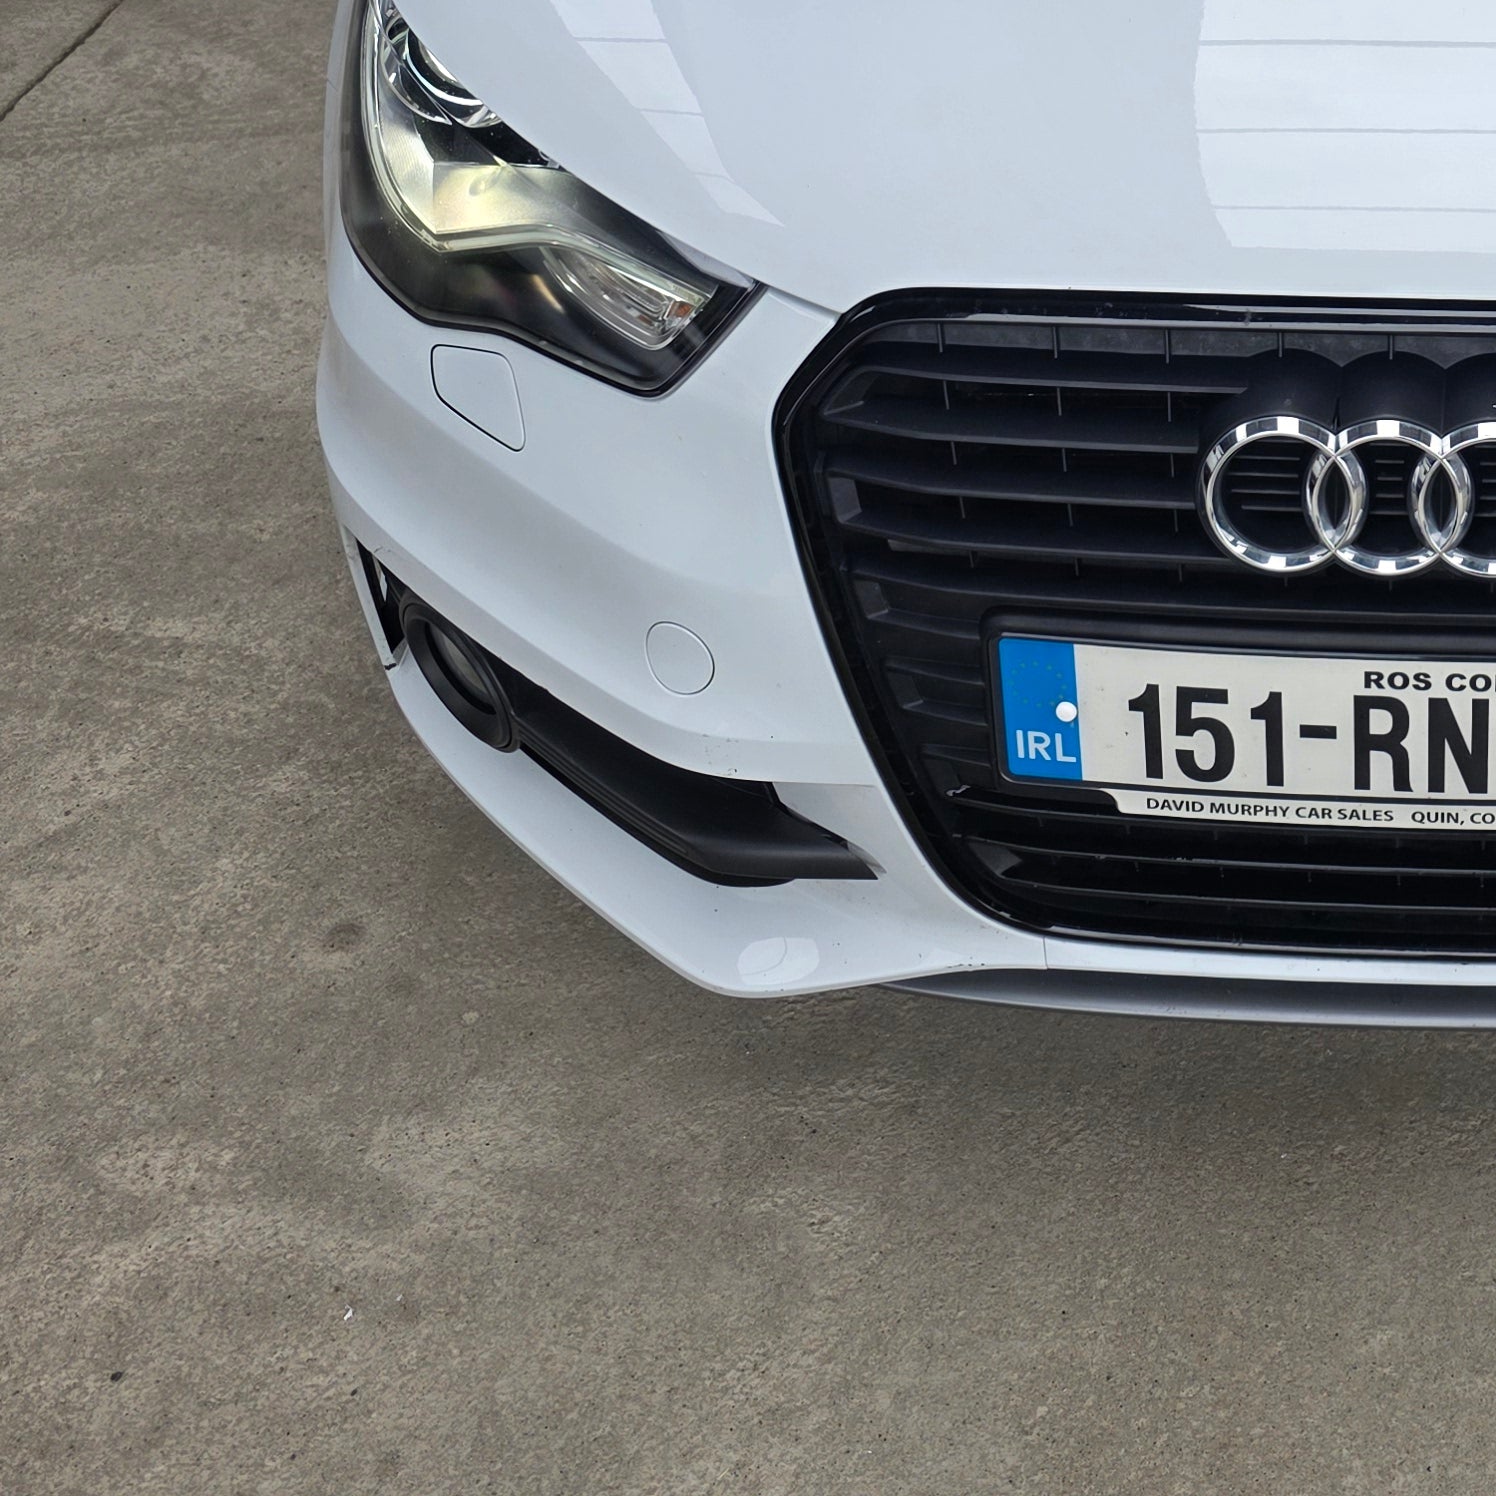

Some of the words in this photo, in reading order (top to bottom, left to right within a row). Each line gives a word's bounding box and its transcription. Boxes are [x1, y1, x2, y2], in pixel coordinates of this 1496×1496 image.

[1363, 670, 1433, 691] ROS
[1015, 729, 1078, 763] IRL
[1146, 797, 1205, 813] DAVID
[1209, 802, 1290, 818] MURPHY
[1295, 806, 1333, 820] CAR
[1337, 808, 1394, 822] SALES
[1410, 811, 1465, 826] QUIN,
